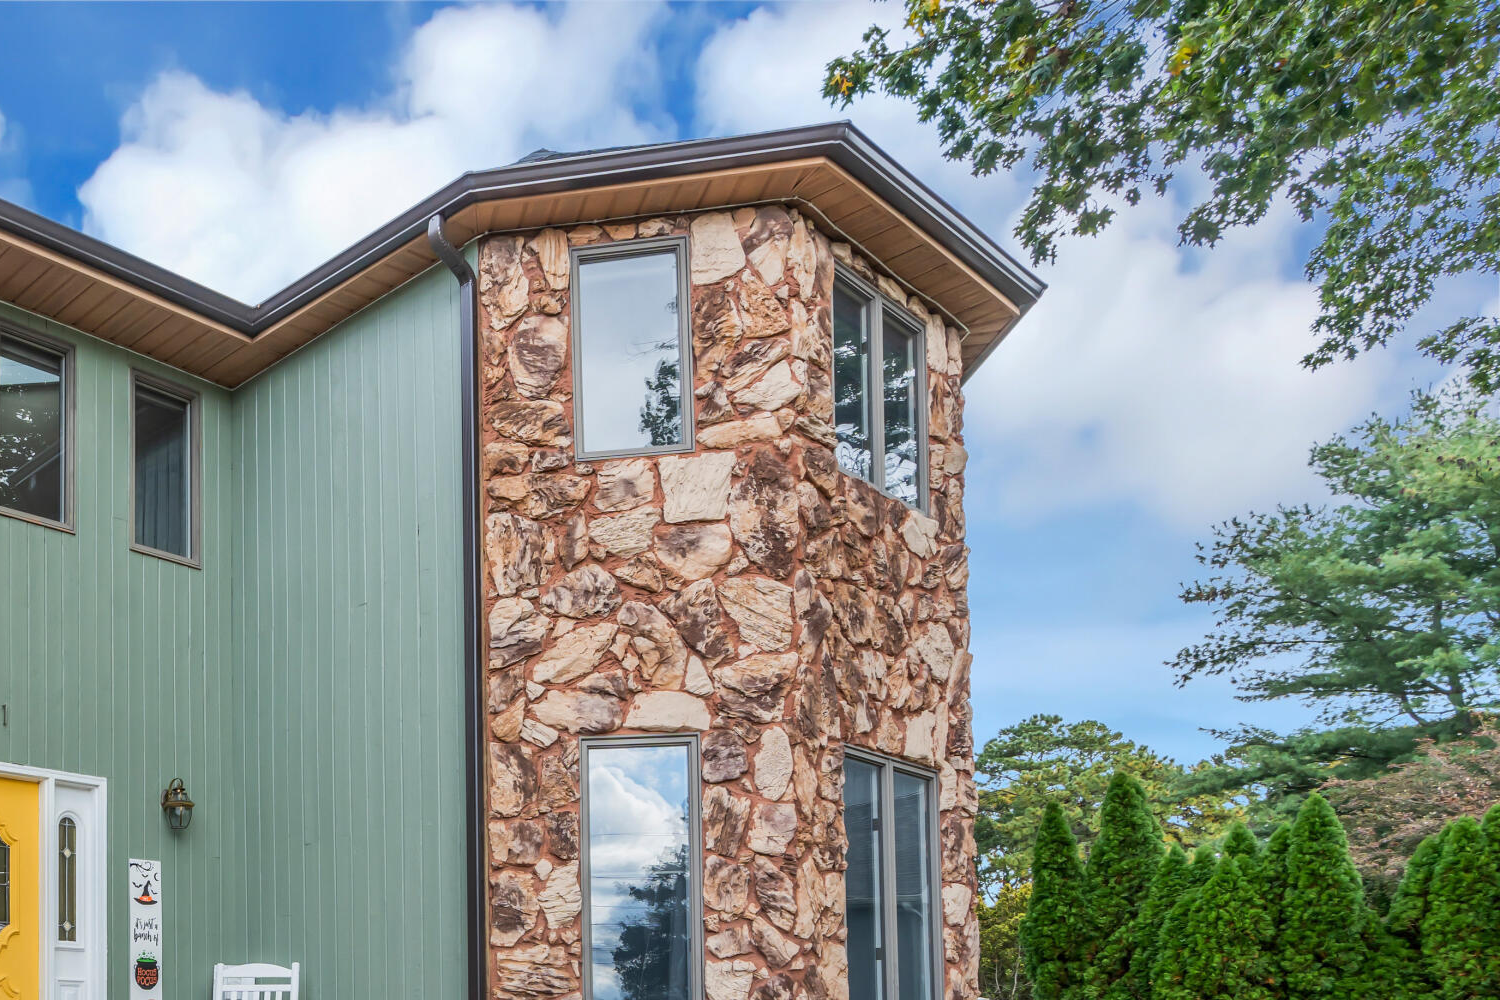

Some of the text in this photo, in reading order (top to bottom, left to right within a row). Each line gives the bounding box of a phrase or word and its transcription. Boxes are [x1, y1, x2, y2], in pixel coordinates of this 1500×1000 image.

[133, 928, 152, 943] bunch
[137, 967, 157, 977] HOCUS
[136, 976, 157, 986] POCUS
